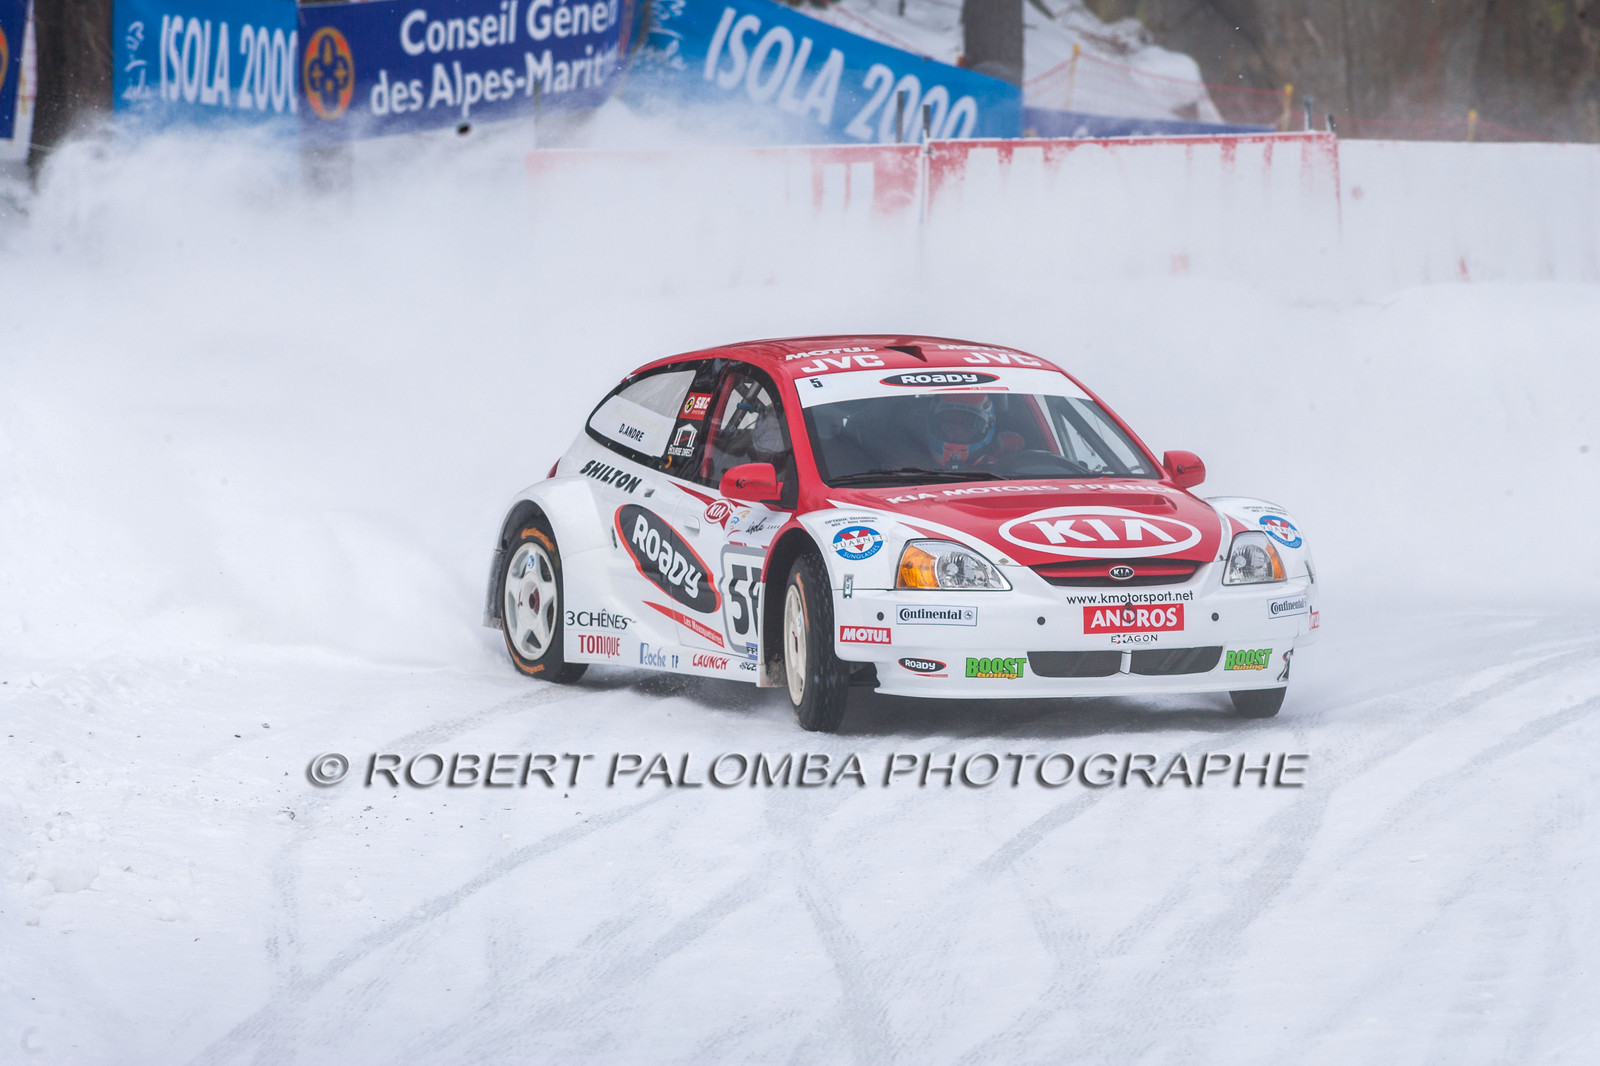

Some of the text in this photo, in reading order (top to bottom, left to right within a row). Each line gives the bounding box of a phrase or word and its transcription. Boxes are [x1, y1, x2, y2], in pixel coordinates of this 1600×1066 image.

[400, 0, 516, 55] Conseil
[160, 14, 230, 107] ISOLA
[704, 6, 978, 142] ISOLA 2000
[370, 69, 423, 115] des
[786, 346, 876, 361] MOTUL
[963, 352, 1042, 367] JVC
[801, 355, 885, 373] JVC
[809, 378, 823, 388] 5
[618, 423, 645, 442] D.ANDRE
[579, 460, 642, 494] SHILTON
[887, 491, 938, 504] KIA
[942, 485, 1060, 497] MOTORS
[707, 503, 729, 519] KIA
[1030, 518, 1177, 544] KIA
[832, 535, 883, 550] VUARNET
[842, 545, 880, 560] SUNGLASSES
[1113, 568, 1131, 577] KIA
[1066, 590, 1193, 604] www.kmotorsport.net
[1271, 597, 1304, 614] Continental
[900, 608, 962, 621] Continental
[1091, 607, 1178, 629] ANDROS
[842, 628, 889, 642] MOTUL
[578, 635, 620, 659] TONIQUE
[640, 642, 666, 668] Roche
[692, 653, 730, 670] LAUNCH
[965, 657, 1027, 678] BOOST
[1224, 648, 1272, 671] BOOST
